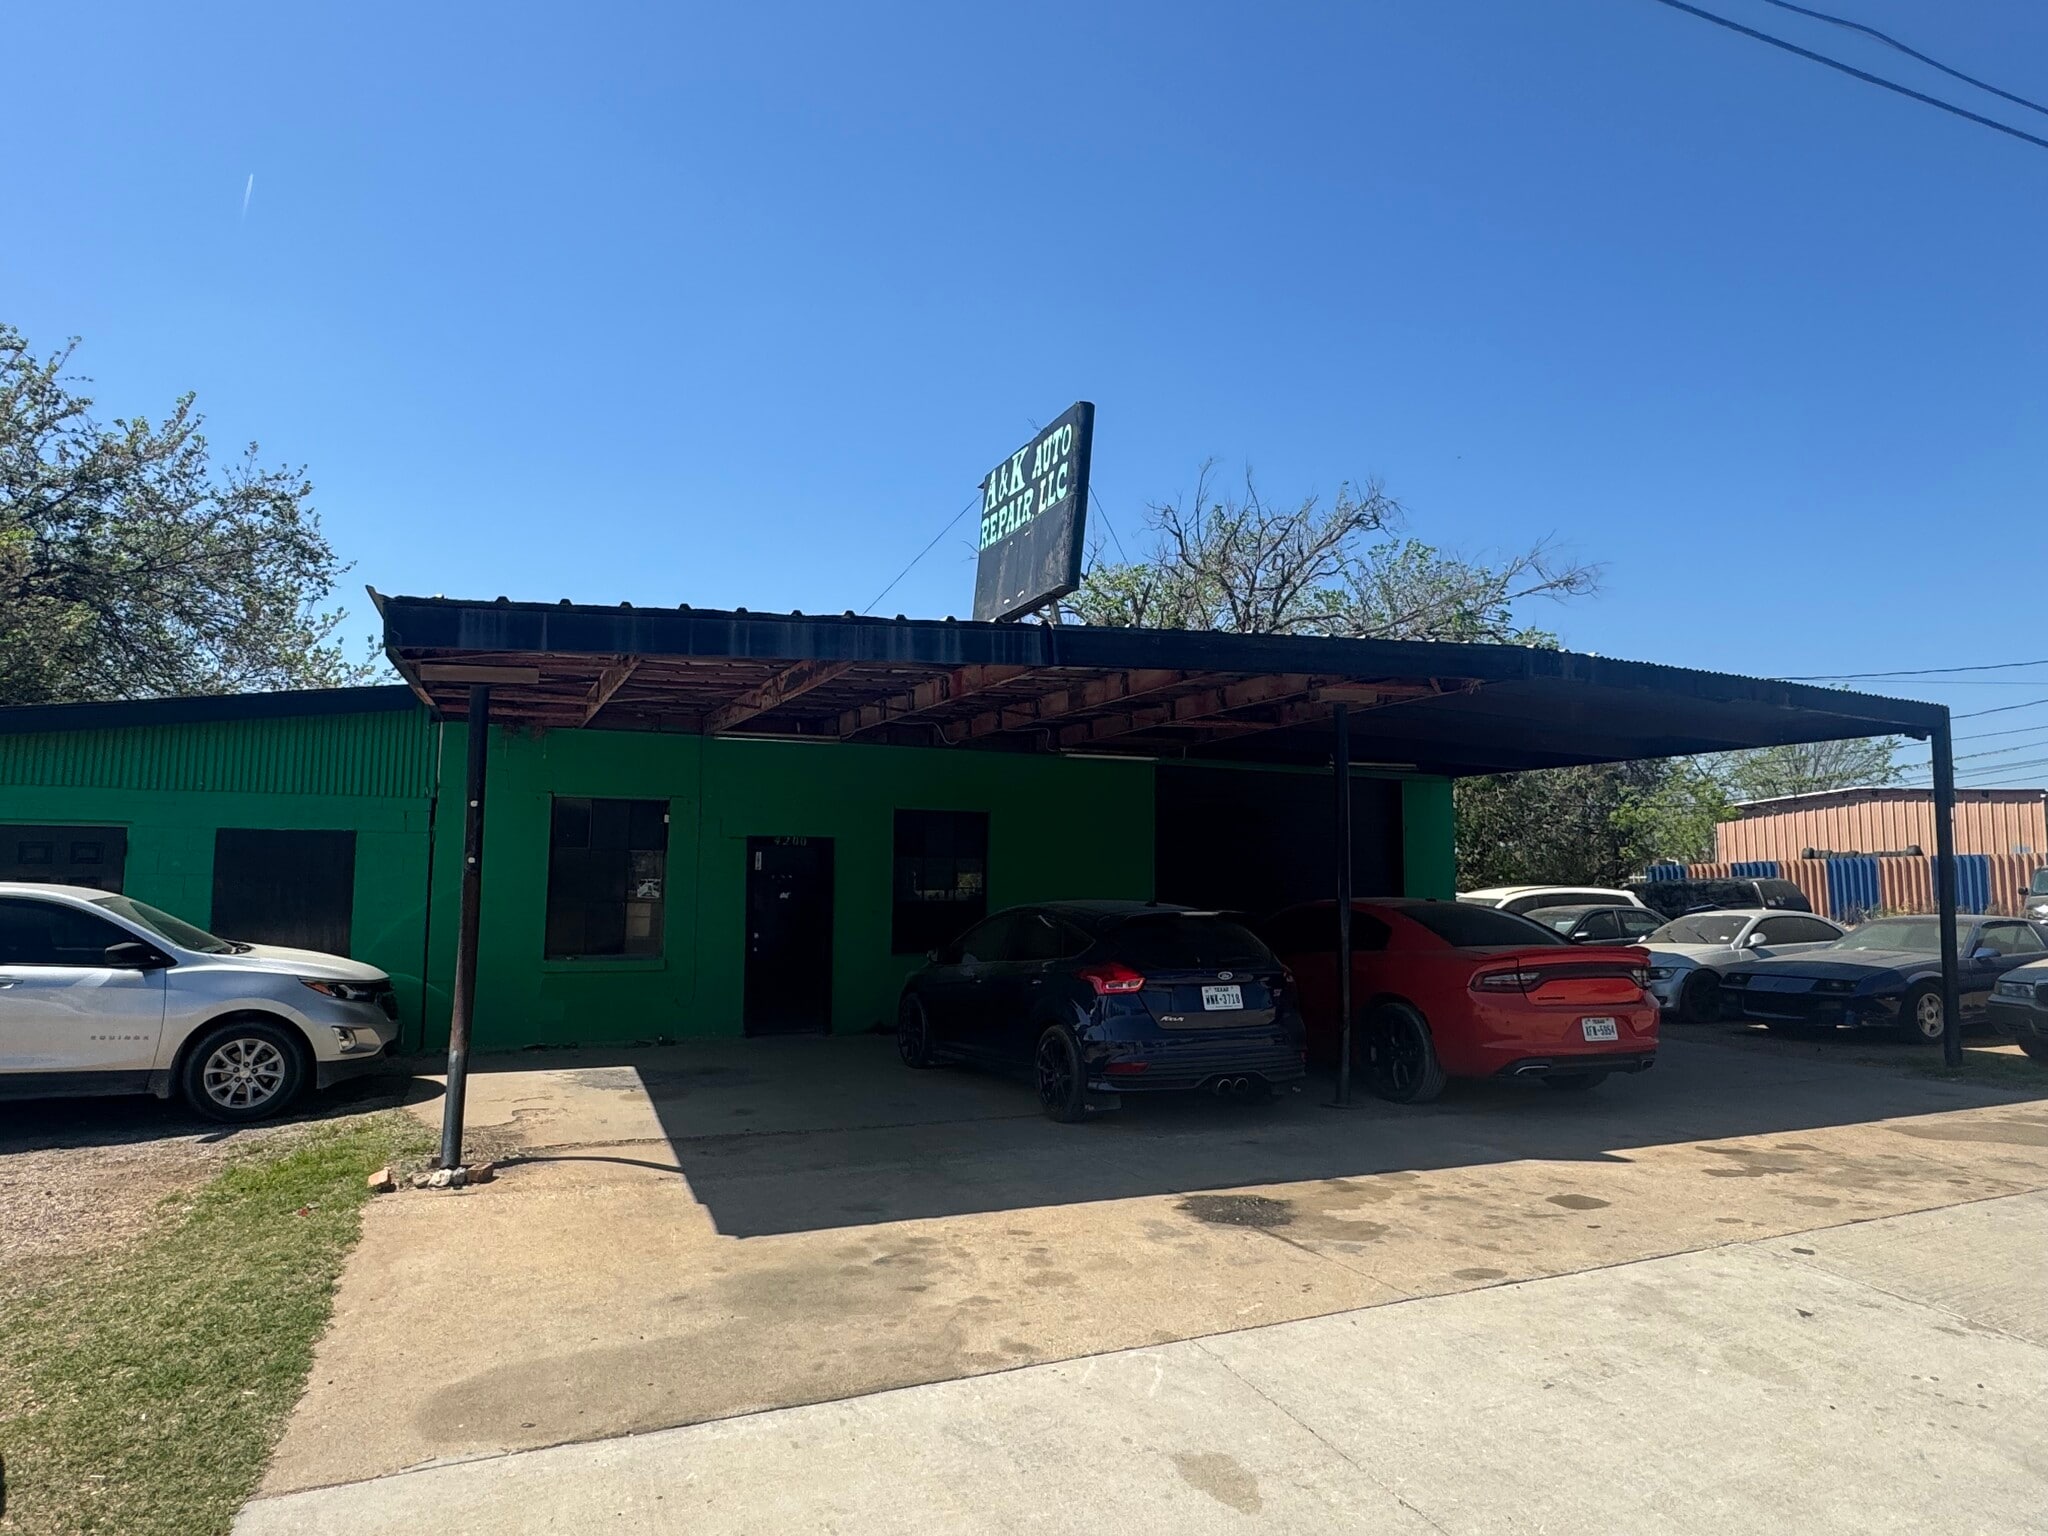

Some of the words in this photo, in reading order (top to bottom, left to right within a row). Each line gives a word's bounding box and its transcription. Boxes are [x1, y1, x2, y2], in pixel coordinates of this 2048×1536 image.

[984, 446, 1029, 514] A&K
[1032, 423, 1072, 480] AUTO
[1038, 461, 1069, 514] LLC
